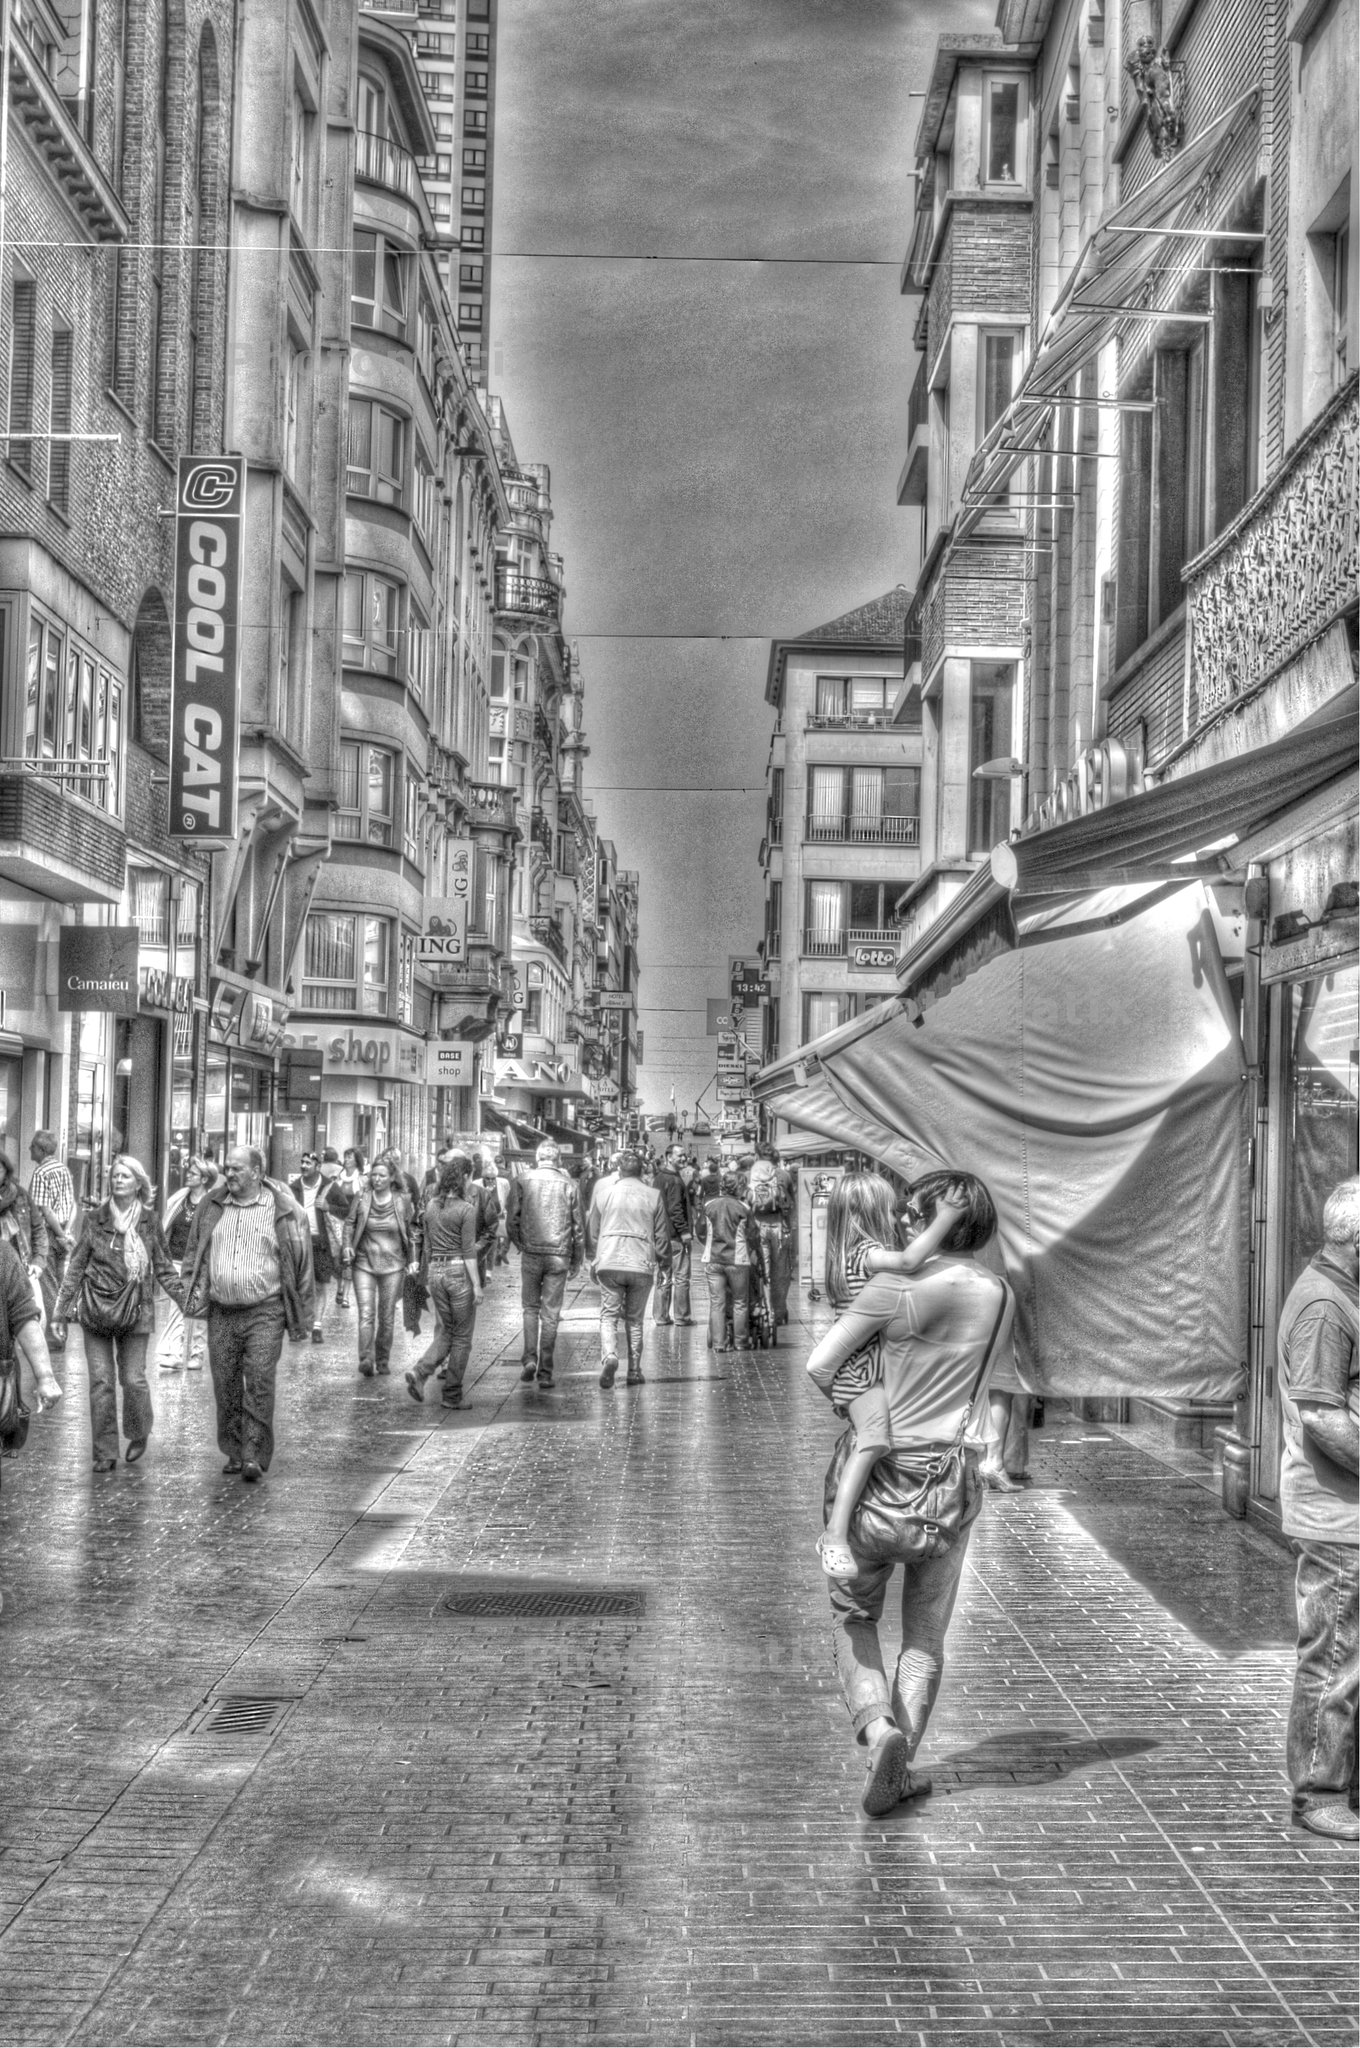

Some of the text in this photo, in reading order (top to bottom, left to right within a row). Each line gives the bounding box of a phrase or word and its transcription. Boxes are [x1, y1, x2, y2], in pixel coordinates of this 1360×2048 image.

[182, 520, 227, 828] COOL CAT
[419, 938, 461, 954] ING
[736, 983, 767, 993] 13:42
[328, 1028, 390, 1073] shop
[440, 1052, 461, 1060] BASE
[438, 1066, 461, 1078] shop
